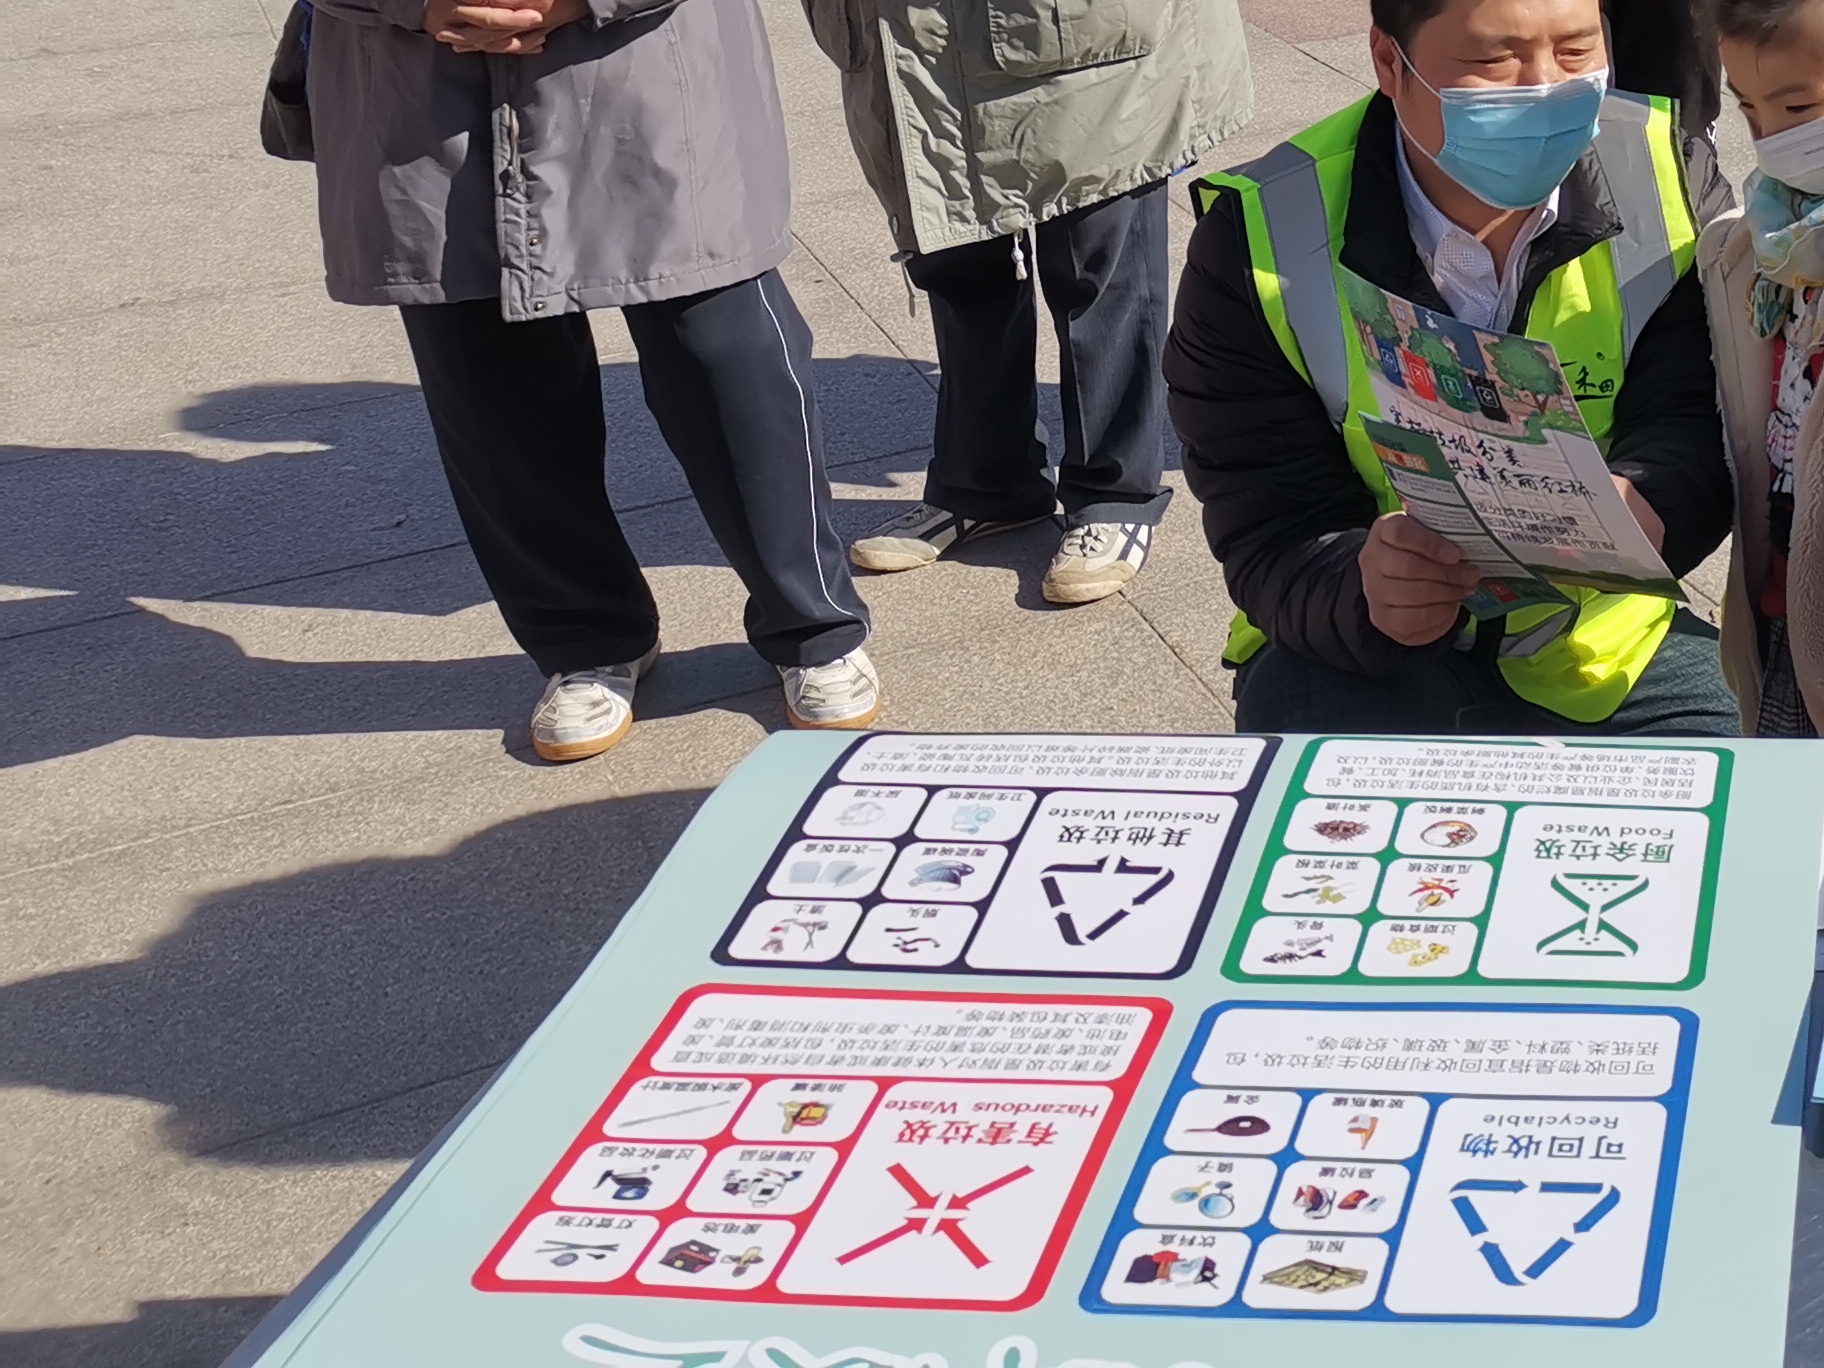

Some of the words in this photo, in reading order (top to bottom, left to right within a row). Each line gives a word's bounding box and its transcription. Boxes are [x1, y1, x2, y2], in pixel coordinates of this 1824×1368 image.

[1047, 807, 1116, 821] Waste
[1124, 809, 1221, 825] Residual
[1056, 824, 1192, 848] 其他垃圾
[1541, 823, 1610, 837] Waste
[1619, 826, 1674, 840] Food
[1533, 838, 1675, 864] 厨余垃圾
[884, 1100, 958, 1115] Waste
[971, 1101, 1099, 1118] Hazardous
[1482, 1113, 1619, 1129] Recyclable
[895, 1119, 1058, 1148] 有害垃圾
[1458, 1132, 1627, 1161] 可回收物
